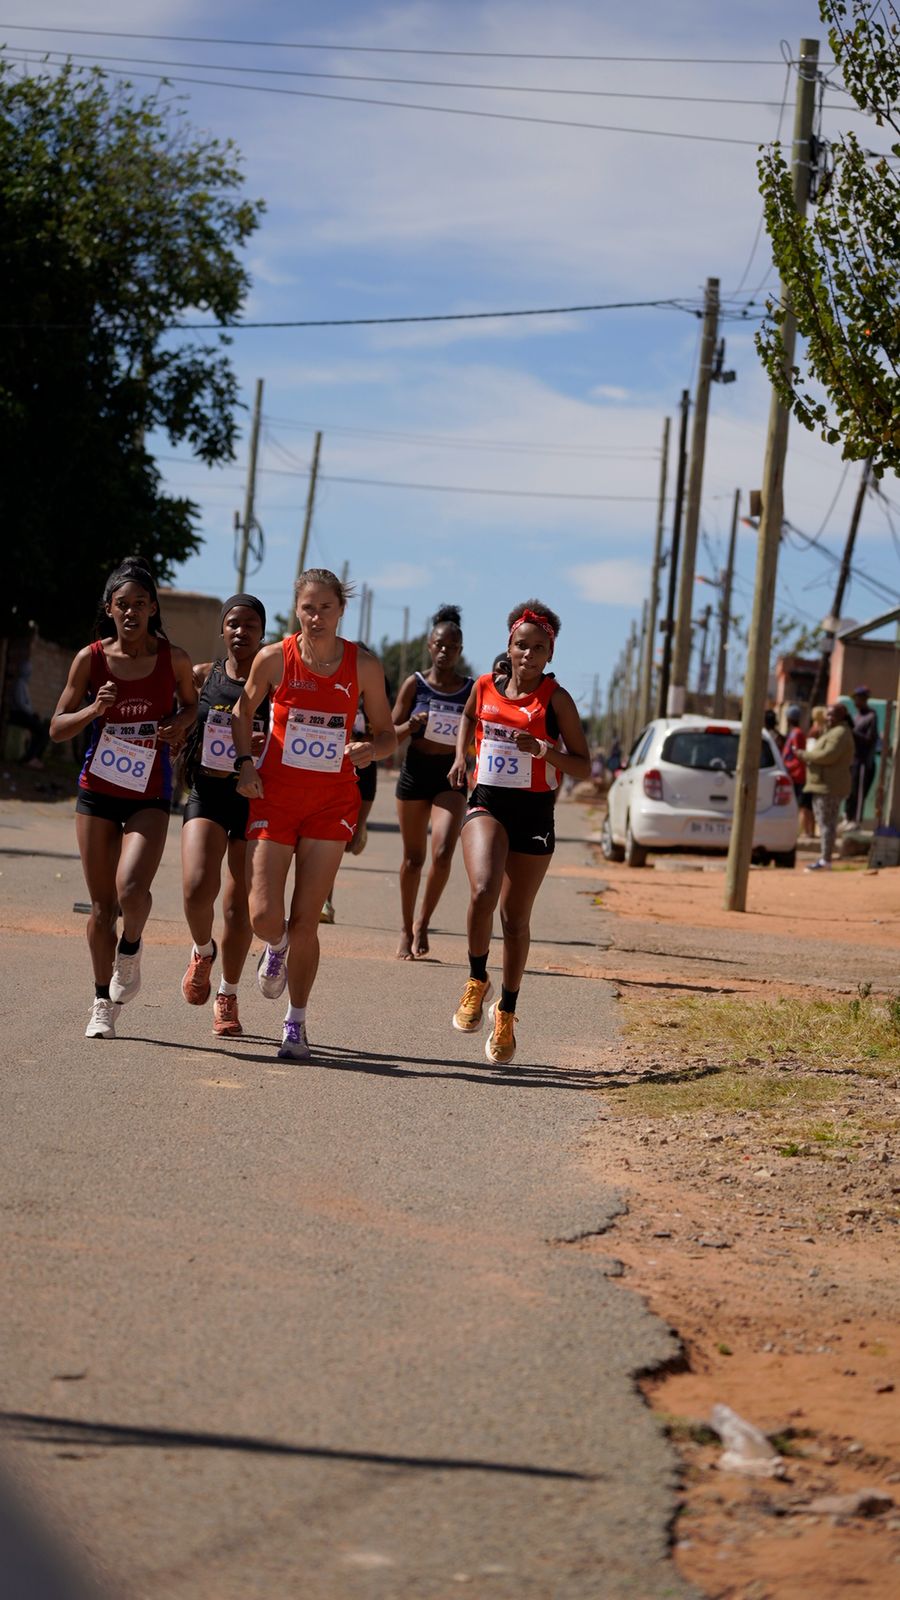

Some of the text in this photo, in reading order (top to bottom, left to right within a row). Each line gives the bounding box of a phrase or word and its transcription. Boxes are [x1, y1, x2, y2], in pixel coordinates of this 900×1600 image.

[310, 716, 324, 724] 2026
[121, 726, 135, 735] 2026
[210, 740, 238, 759] 06
[291, 738, 337, 759] 005
[101, 750, 145, 777] 008
[487, 755, 518, 775] 193
